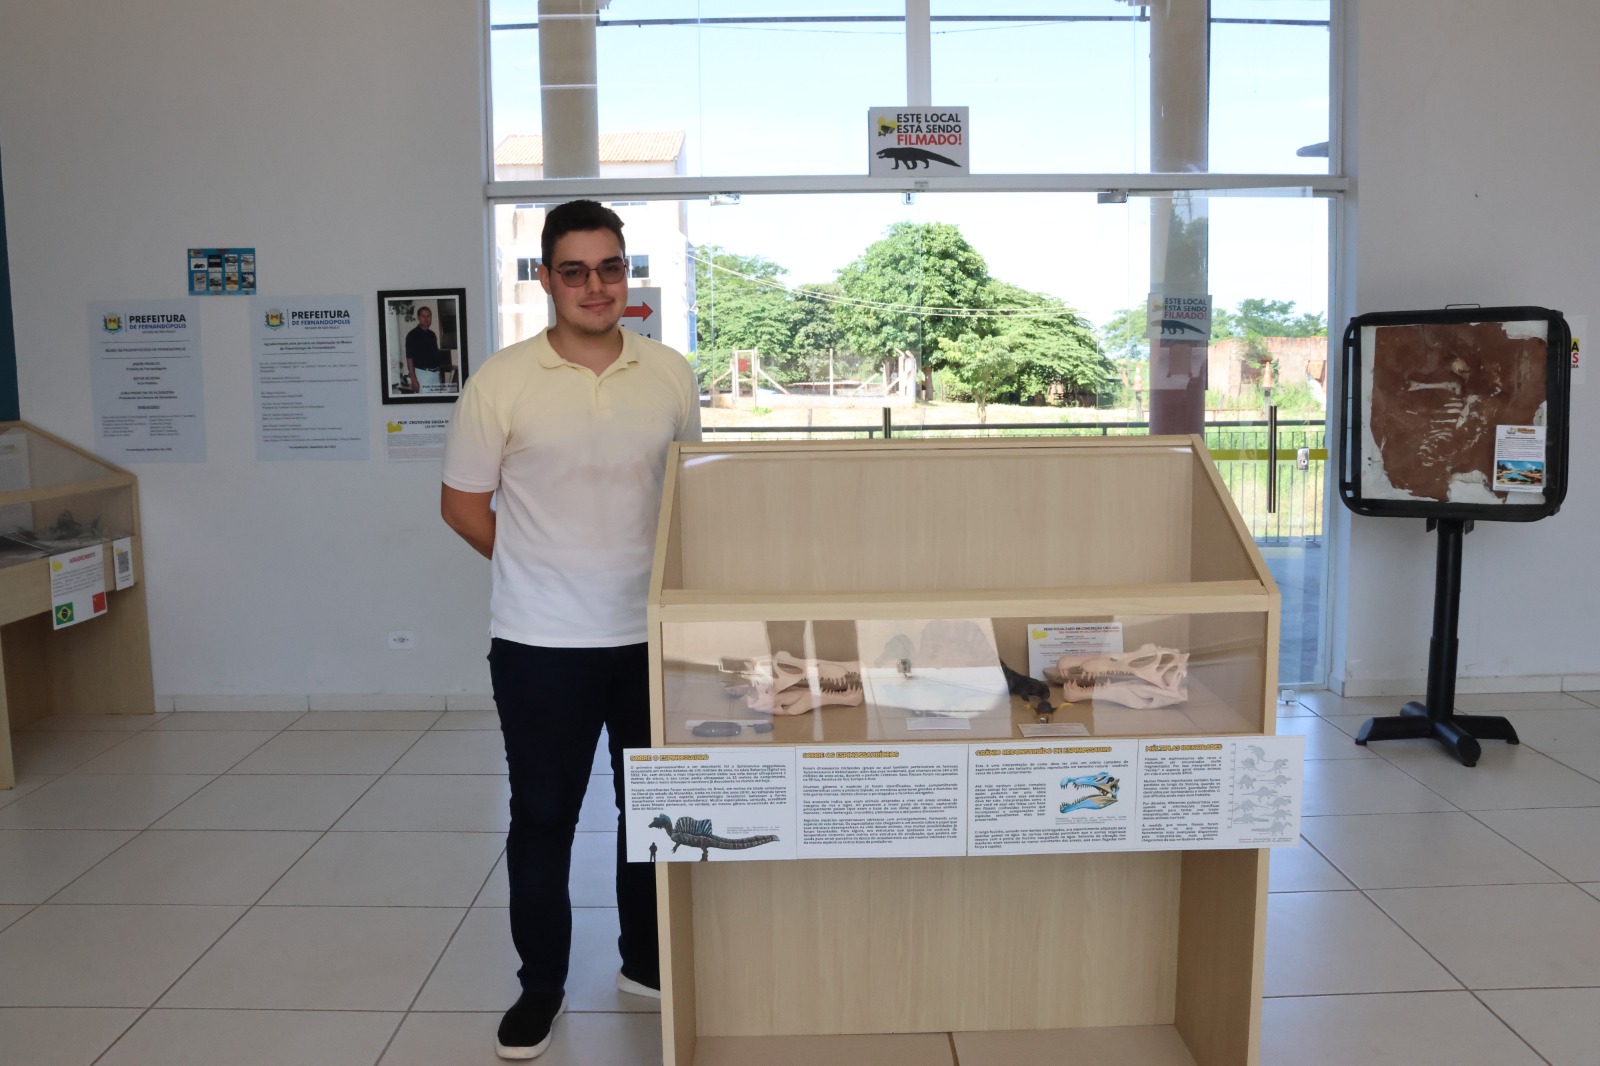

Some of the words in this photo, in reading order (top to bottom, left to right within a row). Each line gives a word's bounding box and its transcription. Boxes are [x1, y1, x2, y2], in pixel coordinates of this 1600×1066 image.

[896, 114, 922, 123] ESTE
[925, 113, 961, 122] LOCAL
[896, 122, 922, 133] ESTÁ
[926, 124, 962, 133] SENDO
[897, 134, 962, 145] FILMADO!
[129, 314, 187, 324] PREFEITURA
[291, 310, 350, 319] PREFEITURA
[1164, 312, 1207, 320] FILMADO!
